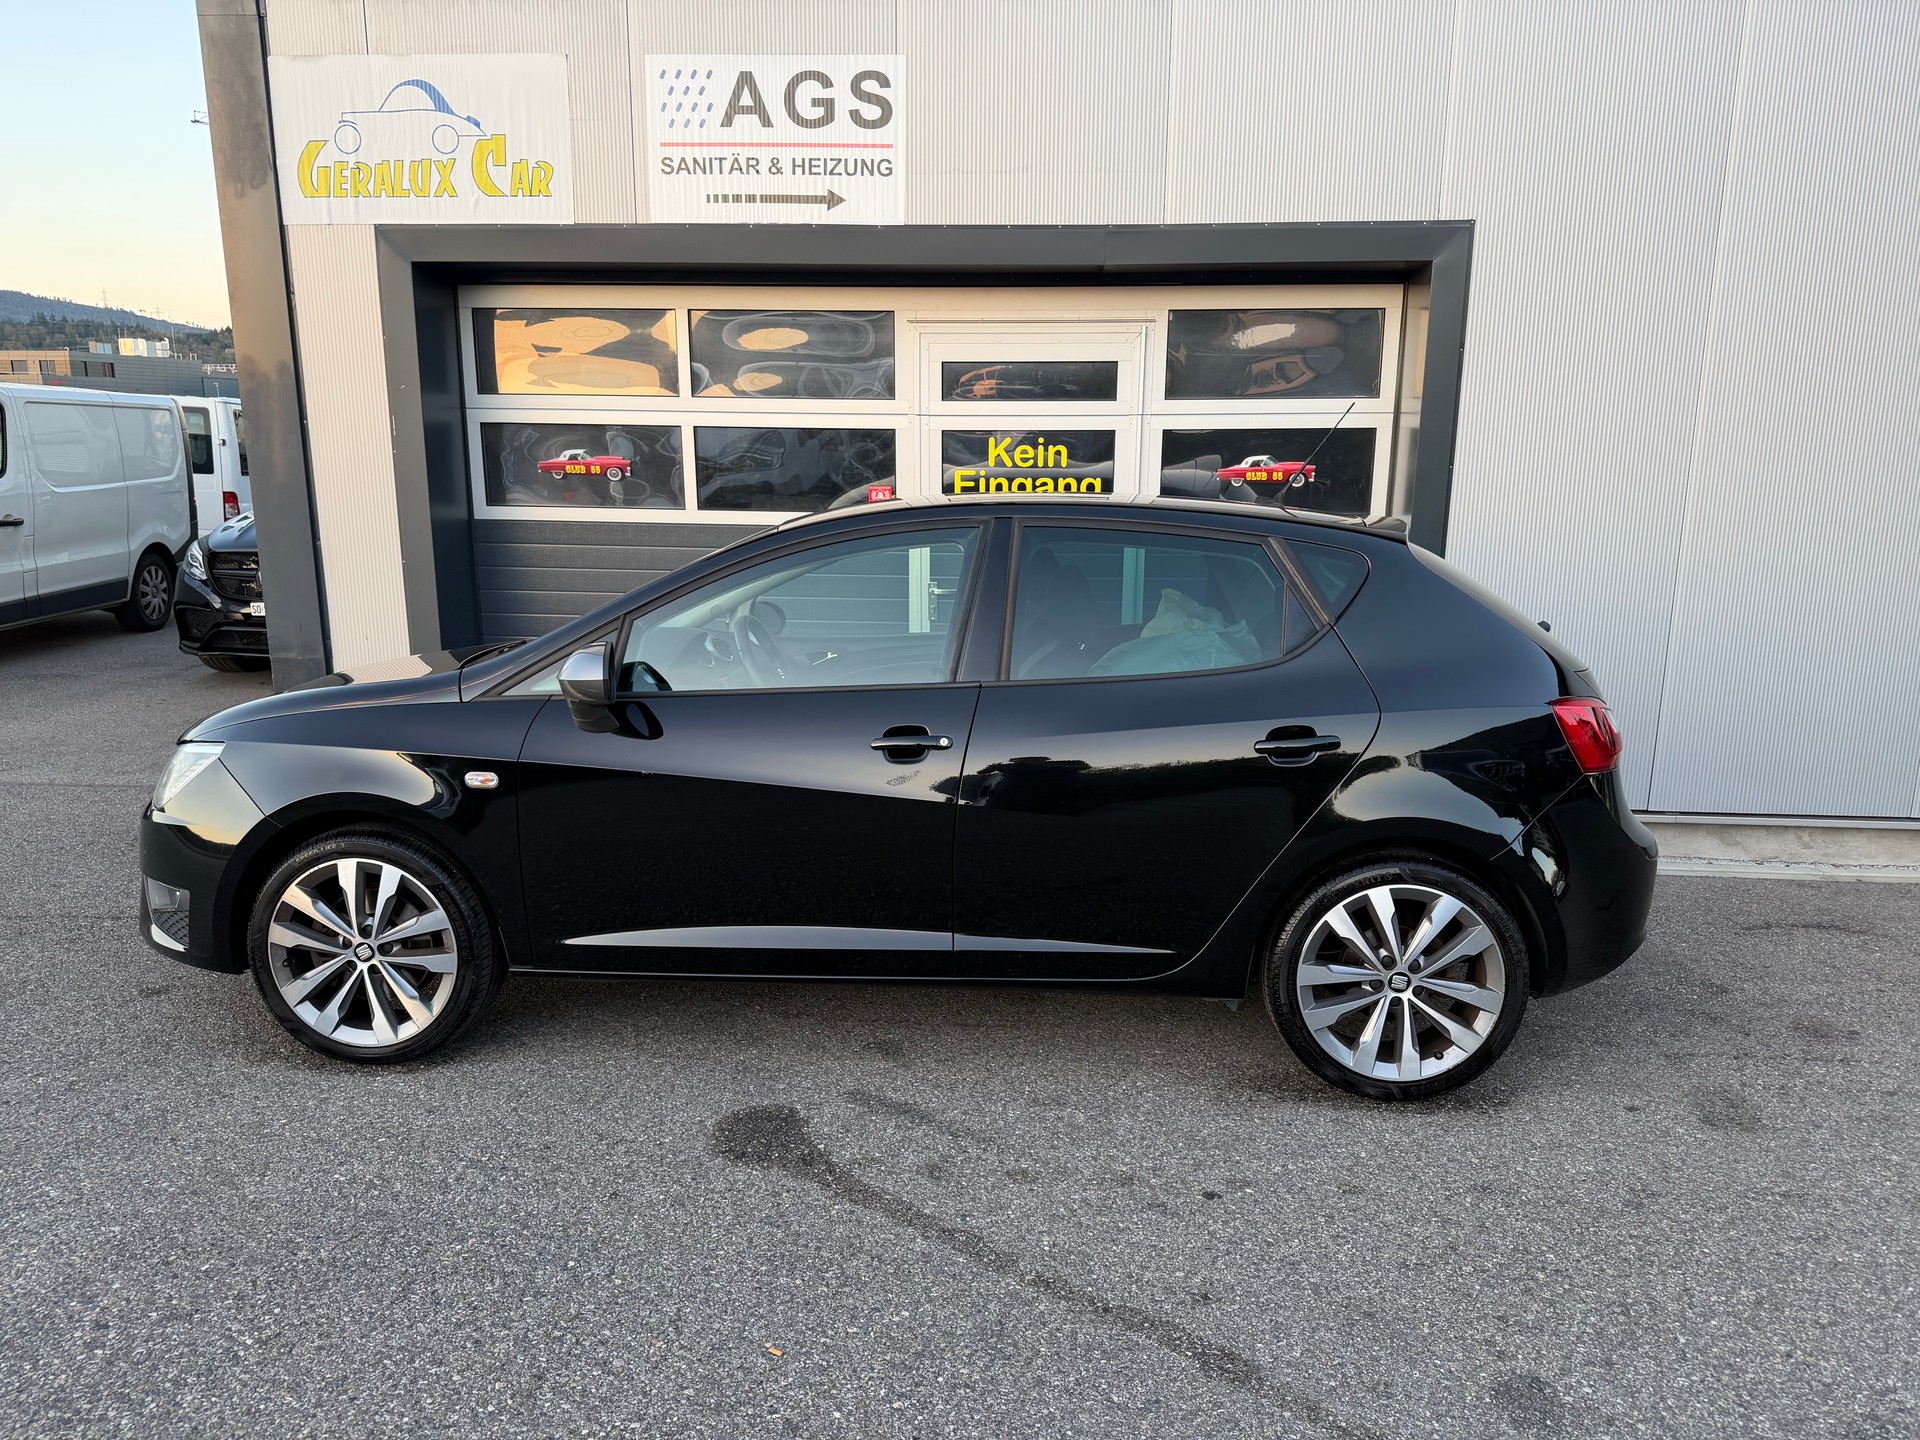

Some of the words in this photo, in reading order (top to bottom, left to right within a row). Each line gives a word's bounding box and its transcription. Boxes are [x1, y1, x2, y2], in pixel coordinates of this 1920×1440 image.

[719, 69, 895, 129] AGS
[297, 138, 458, 199] GERALUX
[660, 152, 761, 176] SANITÄR
[767, 157, 784, 175] &
[792, 157, 894, 177] HEIZUNG
[988, 436, 1069, 468] Kein
[954, 469, 1102, 494] Eingang
